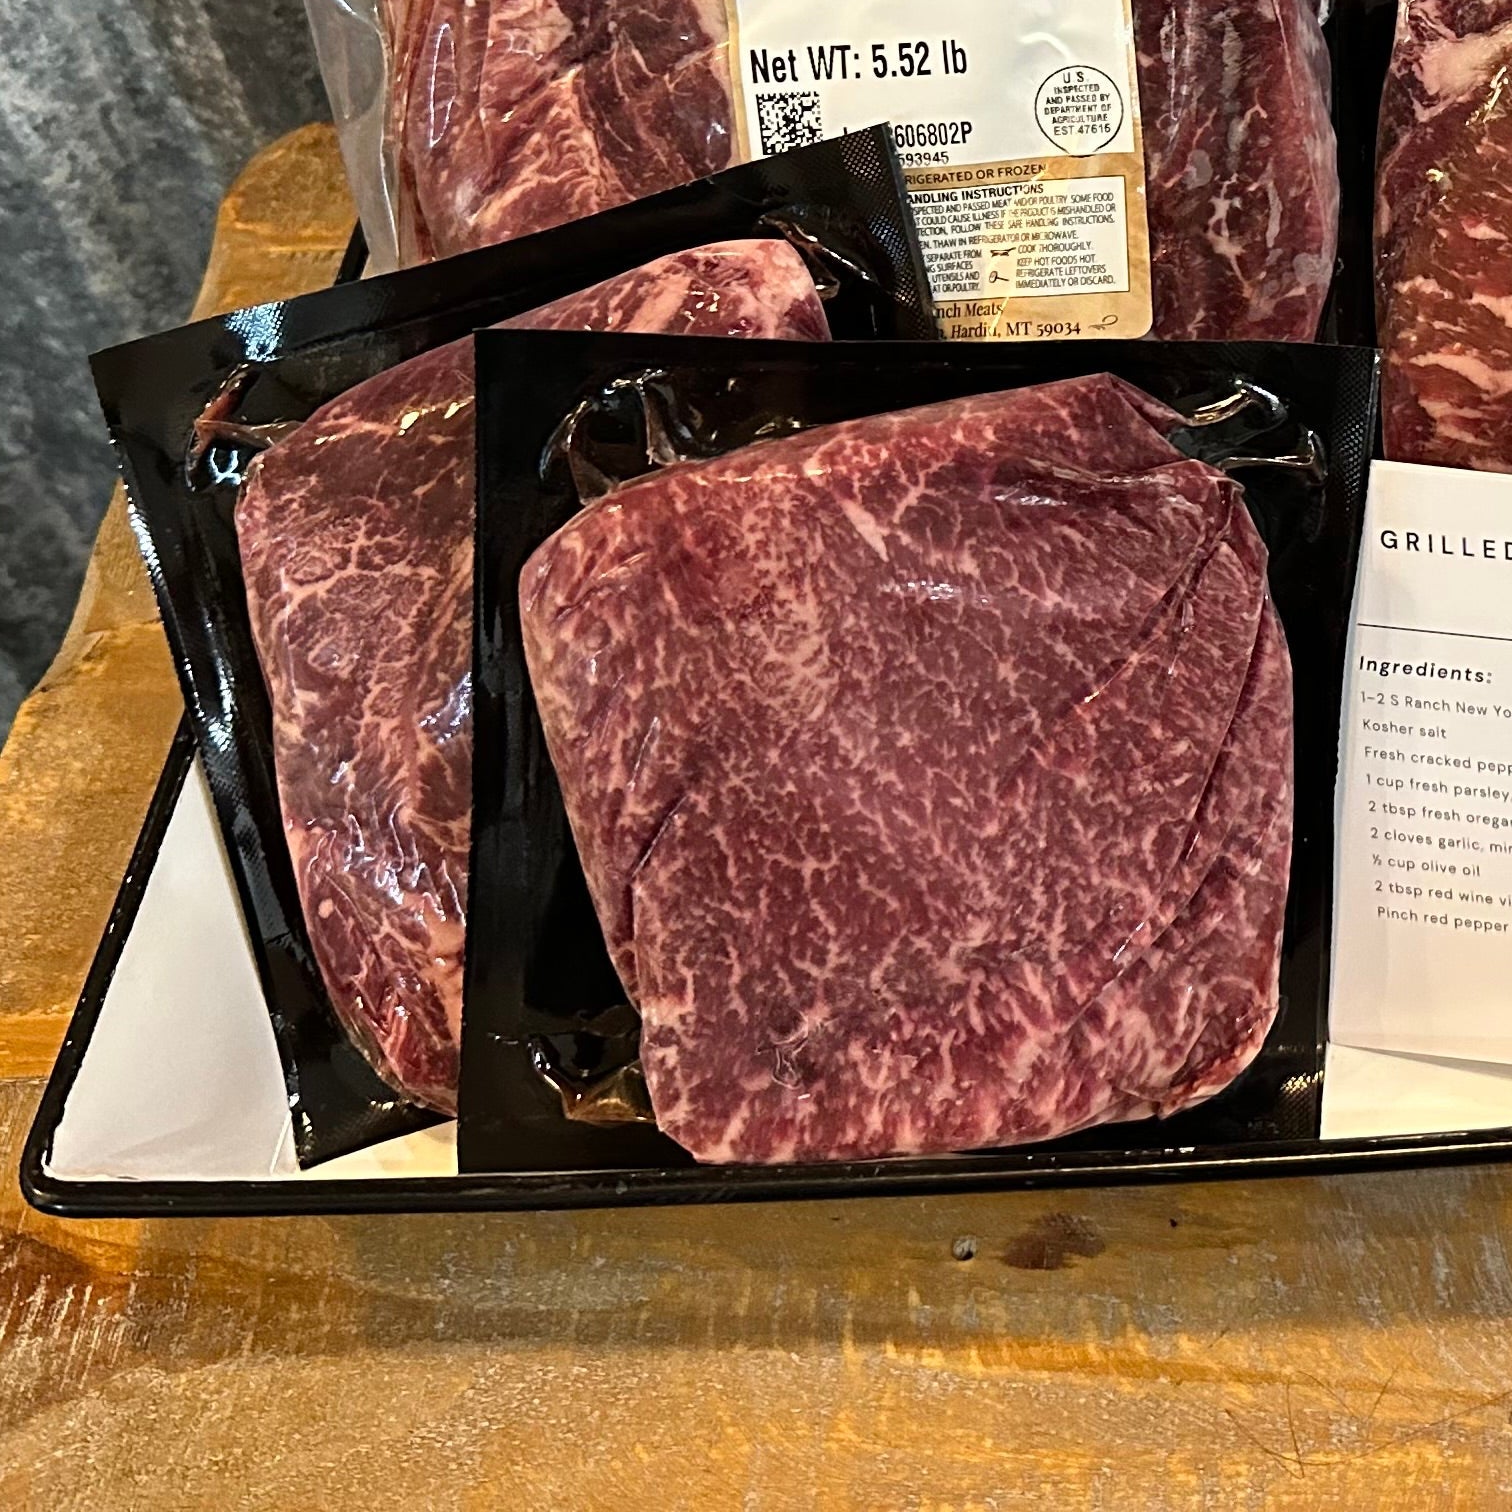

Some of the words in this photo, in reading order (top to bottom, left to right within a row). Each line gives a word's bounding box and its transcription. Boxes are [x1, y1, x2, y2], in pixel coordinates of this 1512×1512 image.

[750, 48, 799, 84] Net
[808, 45, 862, 81] WT:
[872, 41, 931, 78] 5.52
[942, 40, 968, 75] lb
[976, 168, 994, 180] OR
[964, 303, 1003, 317] Meats
[1006, 321, 1032, 336] MT
[1036, 321, 1081, 336] 59034
[1360, 656, 1492, 684] Ingredients:
[1390, 694, 1399, 706] S
[1405, 696, 1450, 712] Ranch
[1456, 702, 1487, 715] New
[1363, 719, 1414, 735] Kosher
[1420, 726, 1446, 739] salt
[1365, 746, 1405, 762] Fresh
[1411, 754, 1471, 768] cracked
[1366, 774, 1370, 784] 1
[1377, 777, 1404, 791] cup
[1410, 778, 1448, 793] fresh
[1454, 786, 1512, 803] parsley,
[1368, 800, 1376, 812] 2
[1382, 802, 1416, 819] tbsp
[1422, 806, 1460, 822] fresh
[1370, 827, 1378, 839] 2
[1384, 829, 1432, 845] cloves
[1438, 837, 1484, 852] garlic,
[1388, 858, 1415, 872] cup
[1422, 860, 1456, 874] olive
[1462, 865, 1480, 876] oil
[1375, 880, 1382, 892] 2
[1388, 882, 1422, 899] tbsp
[1428, 888, 1453, 900] red
[1459, 891, 1493, 904] wine
[1378, 906, 1418, 922] Pinch
[1424, 914, 1448, 925] red
[1454, 918, 1508, 932] pepper
